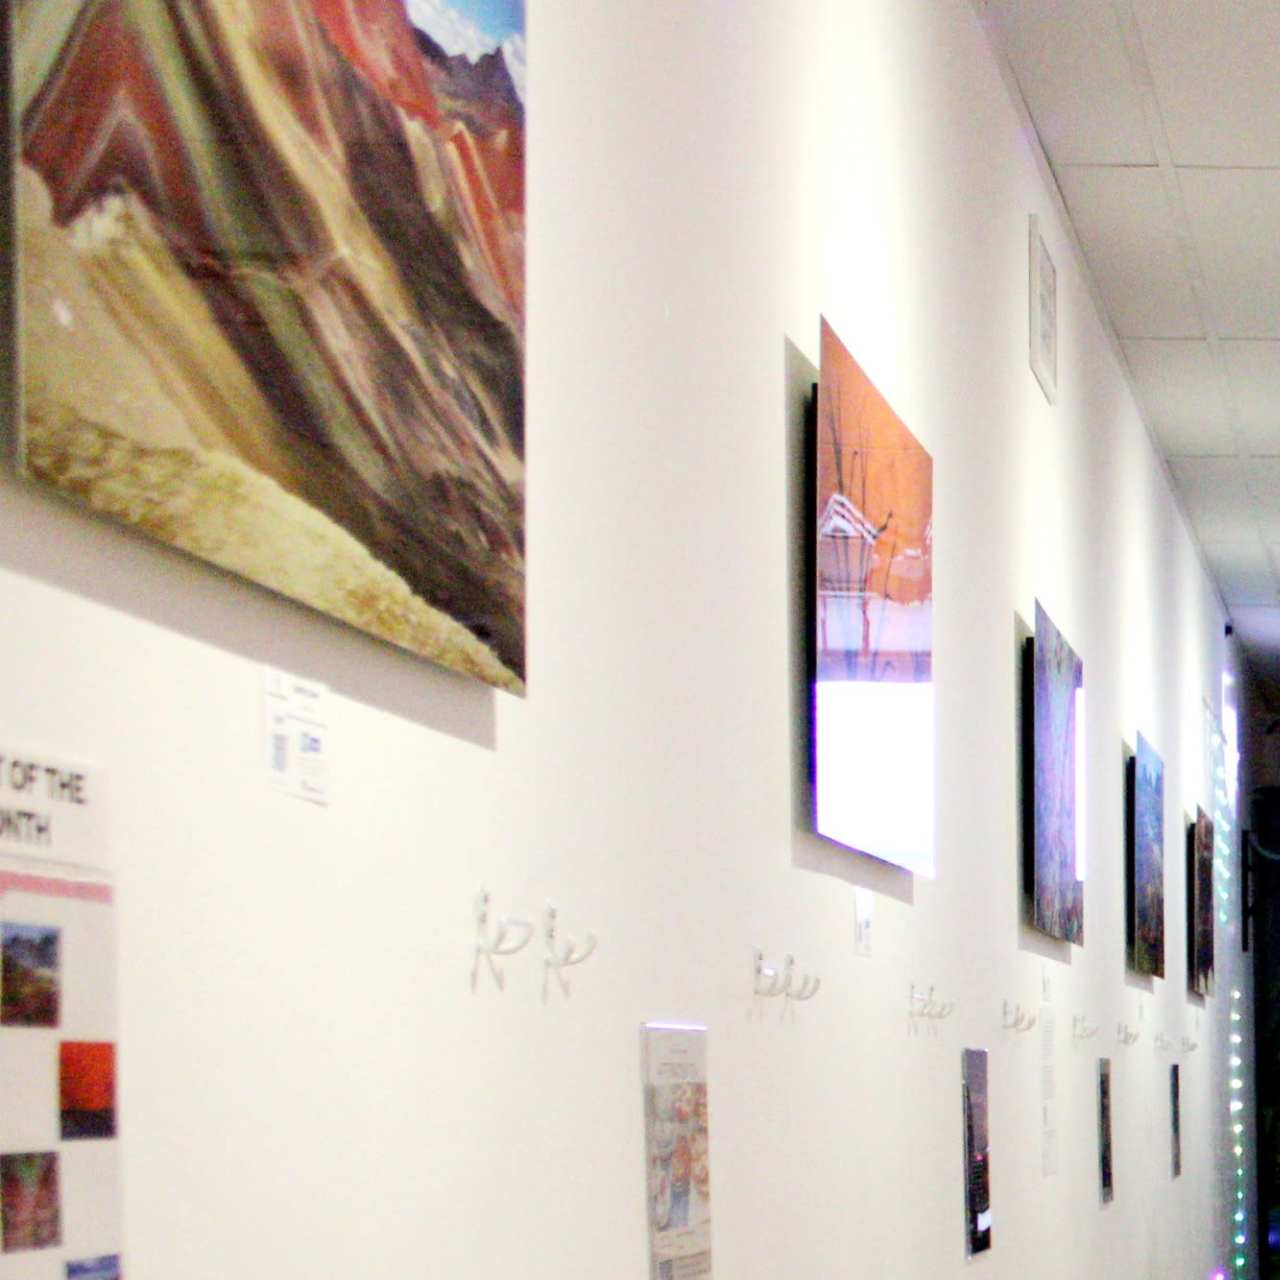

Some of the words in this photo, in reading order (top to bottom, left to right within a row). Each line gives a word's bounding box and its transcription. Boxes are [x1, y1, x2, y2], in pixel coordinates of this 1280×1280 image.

[11, 759, 38, 794] OF
[44, 766, 86, 805] THE
[0, 808, 52, 847] NTH
